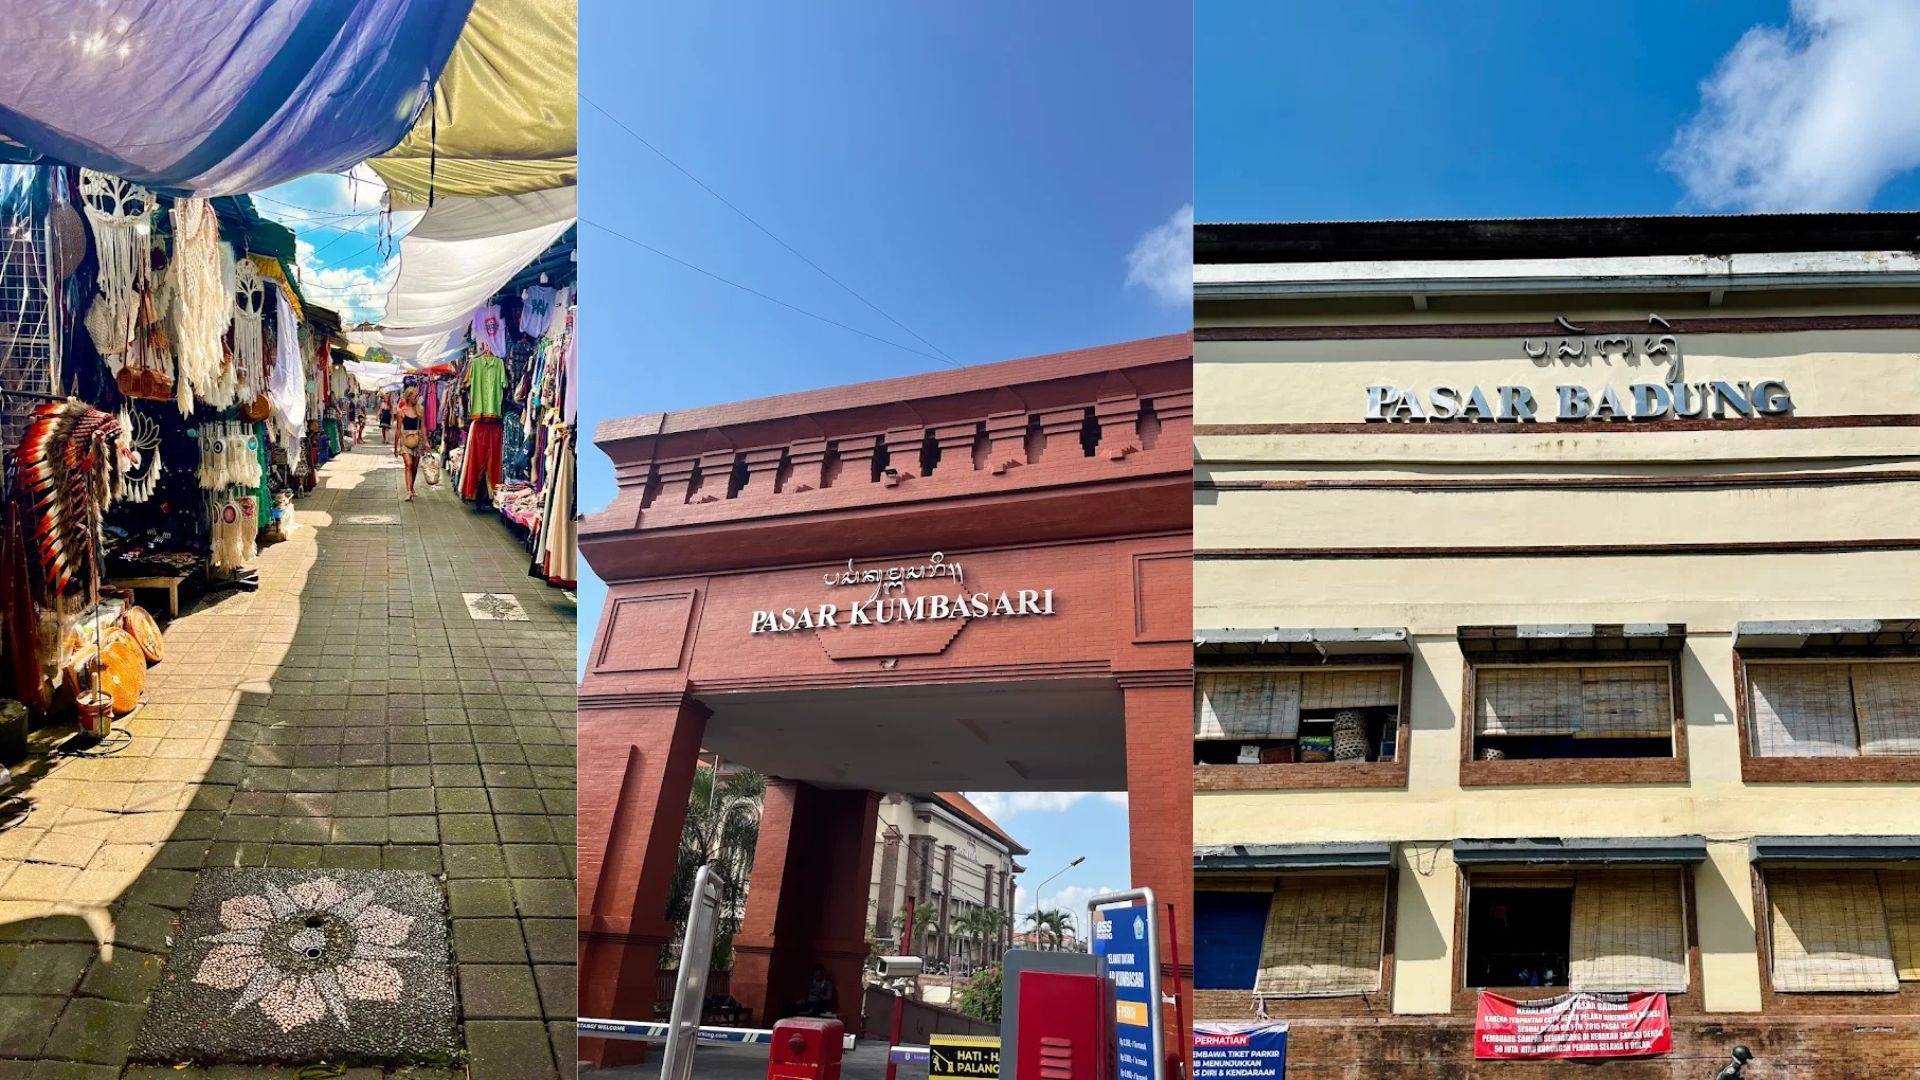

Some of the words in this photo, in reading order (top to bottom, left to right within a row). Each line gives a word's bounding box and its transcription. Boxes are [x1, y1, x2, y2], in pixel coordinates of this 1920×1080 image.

[1364, 385, 1537, 424] PASAR
[1556, 380, 1792, 421] BADUNG
[750, 603, 838, 634] PASAR
[849, 589, 1056, 626] KUMBASARI
[1195, 1036, 1247, 1045] PERHATIAN
[1482, 1034, 1517, 1043] PEMBUANG
[1494, 1045, 1503, 1053] 50
[1599, 1041, 1624, 1050] SELAMA
[957, 1050, 981, 1061] HATI
[1228, 1050, 1249, 1058] TIKET
[1250, 1050, 1280, 1058] PARKIR
[957, 1062, 1000, 1074] PALANG
